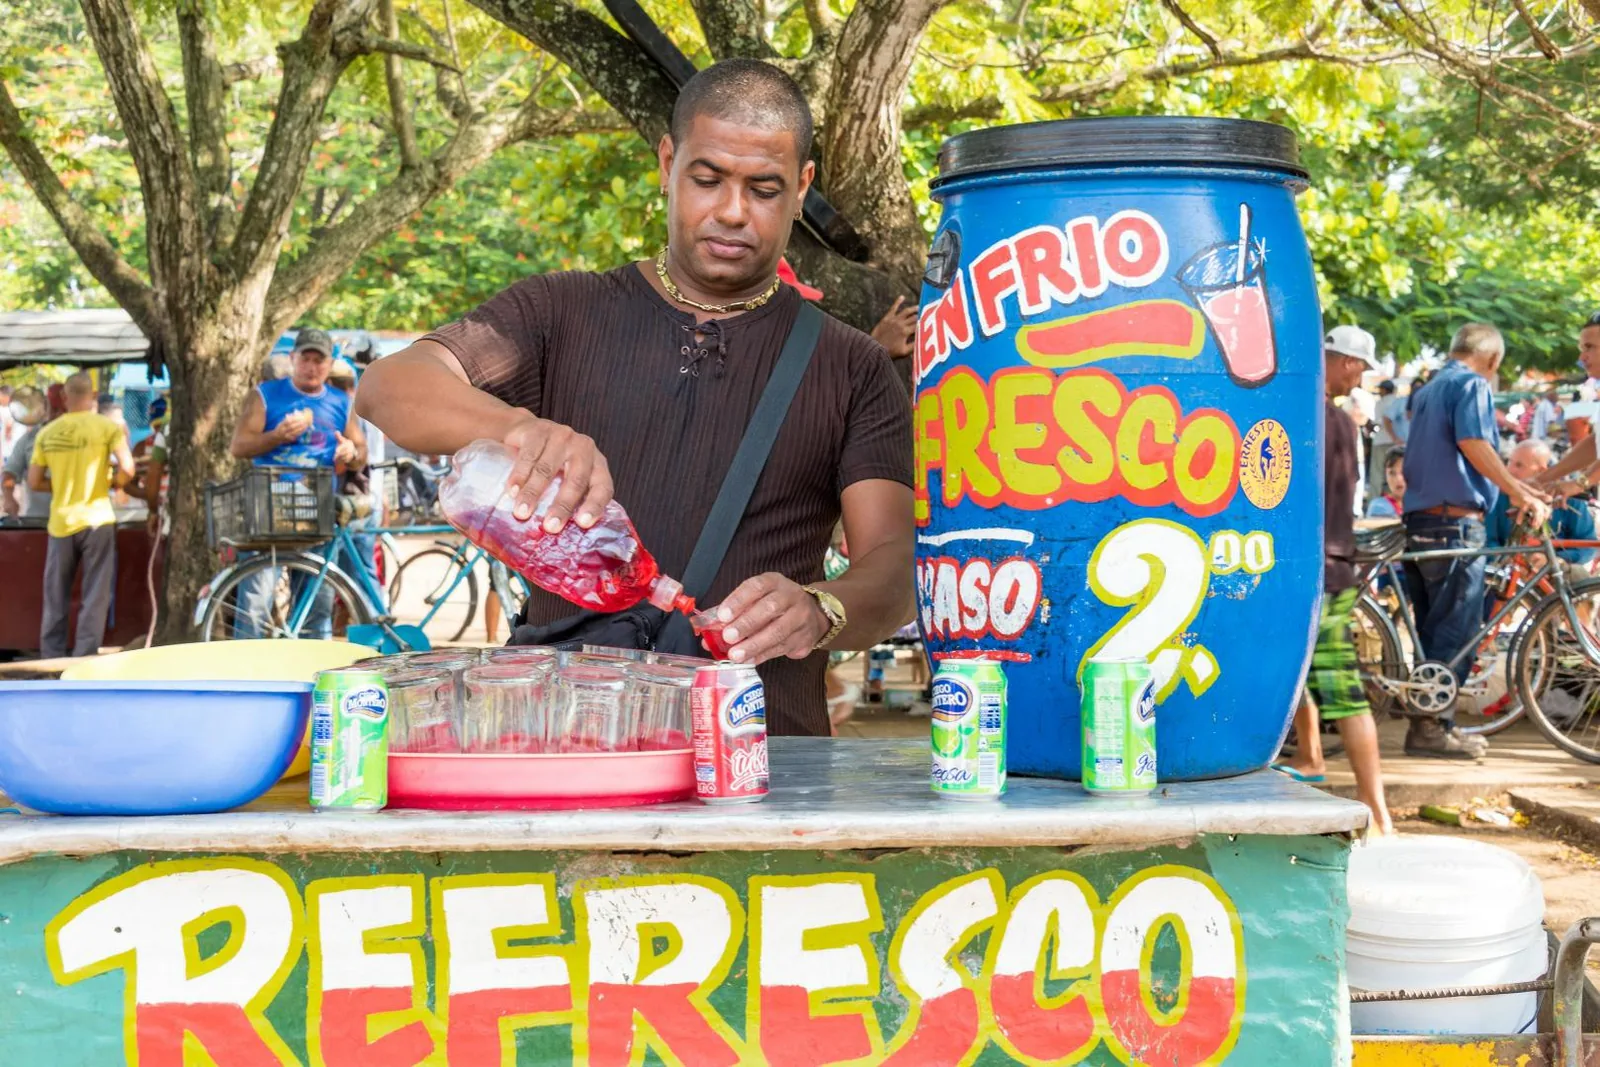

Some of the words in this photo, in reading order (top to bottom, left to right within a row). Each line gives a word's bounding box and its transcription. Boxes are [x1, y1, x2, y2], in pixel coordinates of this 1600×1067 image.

[969, 209, 1169, 337] FRIO
[914, 366, 1241, 527] FRESCO
[1240, 421, 1275, 468] ERNESTO
[1282, 441, 1291, 470] GYM
[44, 856, 1246, 1067] REFRESCO
